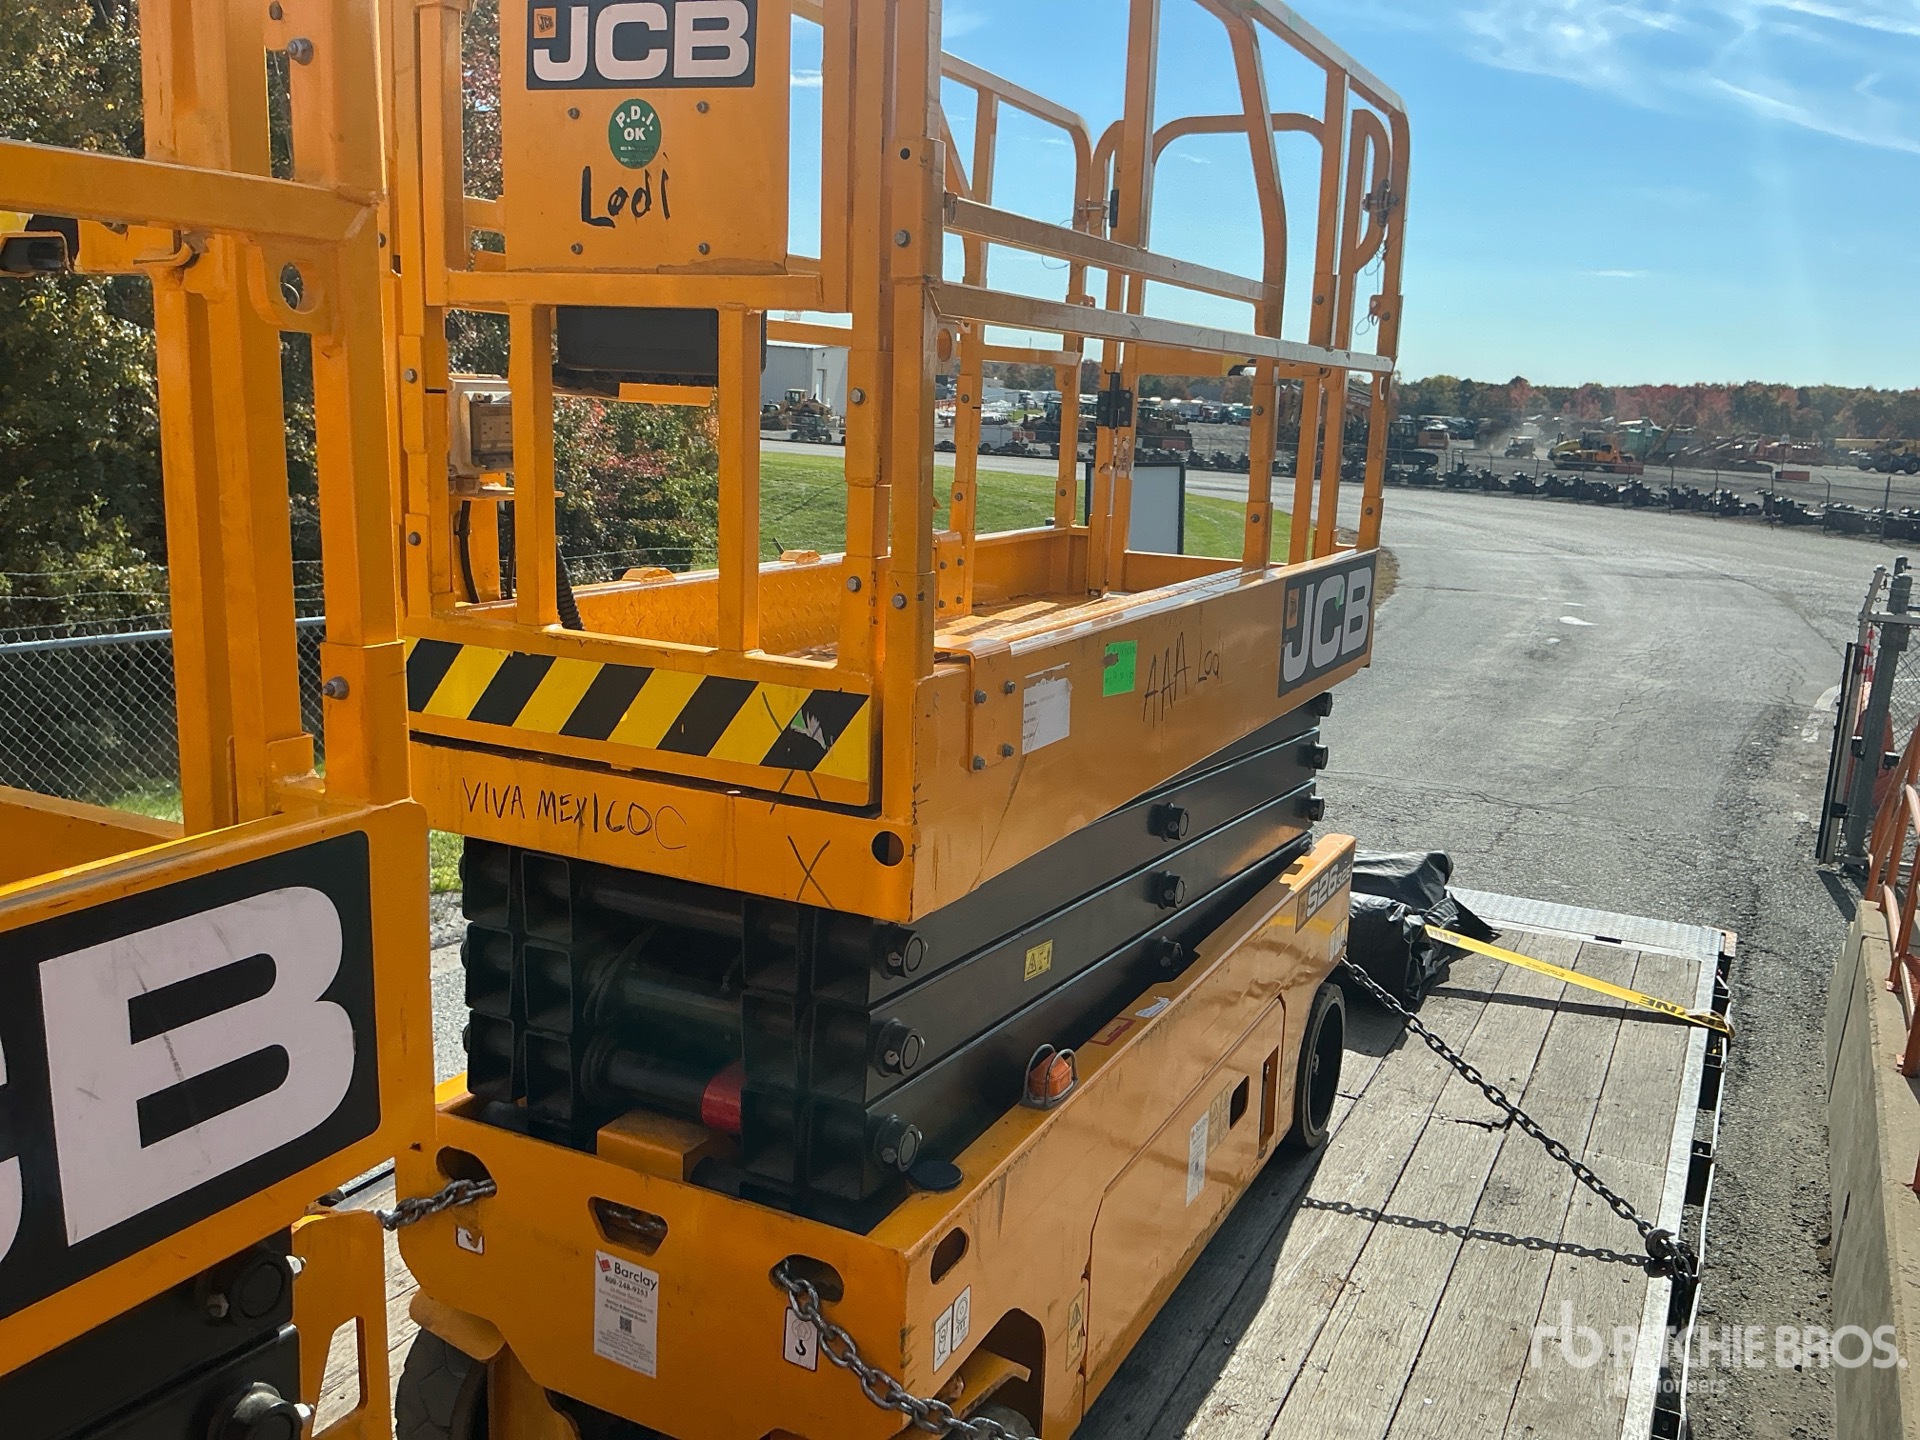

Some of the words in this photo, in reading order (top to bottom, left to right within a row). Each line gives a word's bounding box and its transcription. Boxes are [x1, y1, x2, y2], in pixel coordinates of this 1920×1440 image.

[532, 0, 750, 82] JCB
[623, 127, 646, 141] OK
[1282, 566, 1373, 683] JCB
[462, 777, 526, 820] VIVA
[614, 1261, 658, 1291] Barclay
